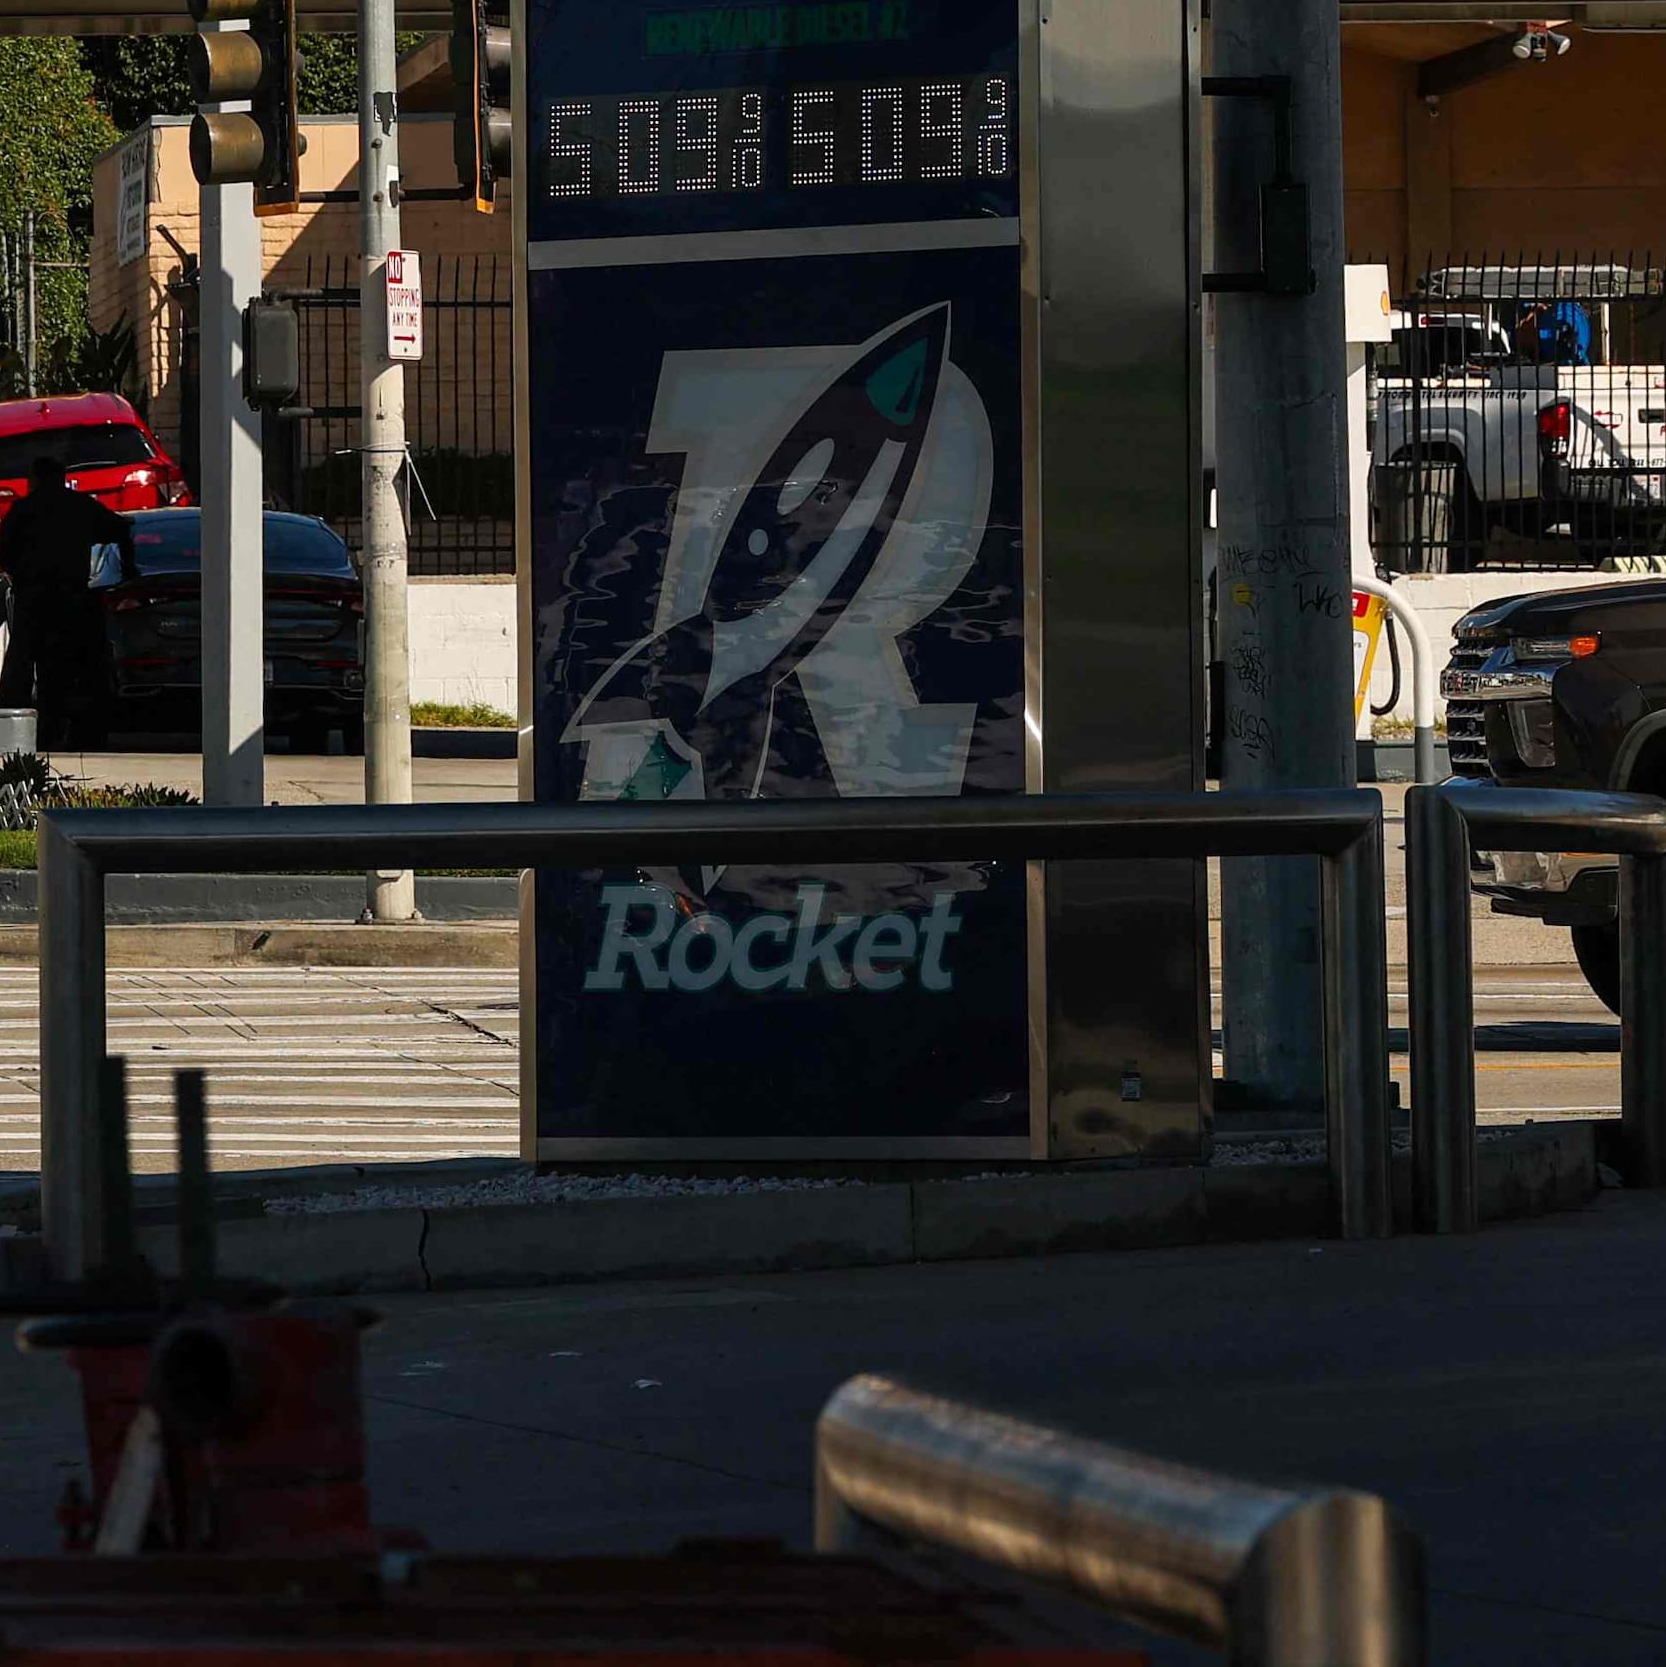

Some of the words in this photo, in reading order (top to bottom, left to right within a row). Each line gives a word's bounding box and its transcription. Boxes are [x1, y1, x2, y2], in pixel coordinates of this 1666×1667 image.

[389, 255, 402, 280] NO
[389, 287, 420, 307] STOPPING
[393, 312, 404, 326] ANY
[406, 313, 417, 327] TIME
[583, 880, 961, 993] Rocket
